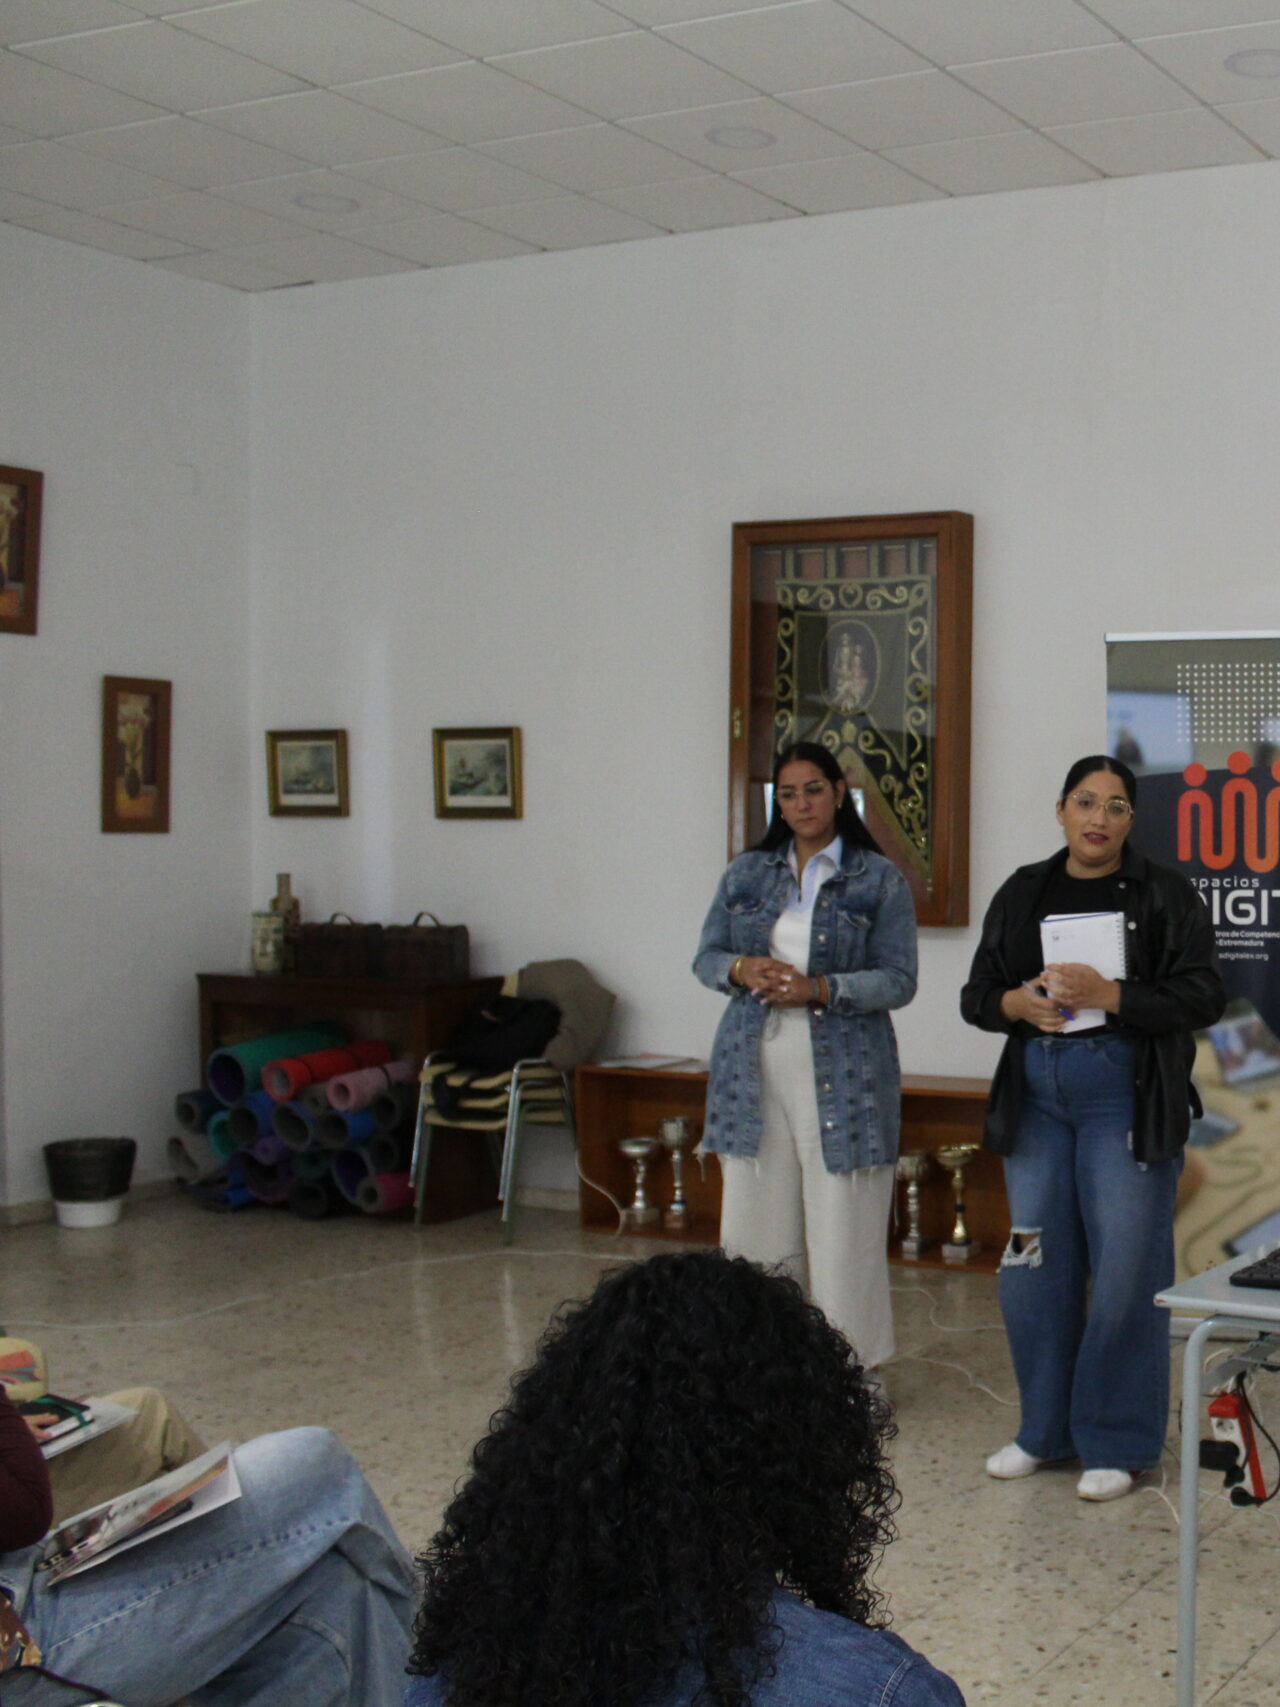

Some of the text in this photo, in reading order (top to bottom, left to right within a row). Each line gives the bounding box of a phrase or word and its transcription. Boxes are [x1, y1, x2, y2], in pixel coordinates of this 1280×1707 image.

[1190, 876, 1260, 889] spacios
[1215, 930, 1229, 938] tros
[1219, 939, 1264, 948] Extremadura
[1218, 951, 1269, 961] sdigitalex.org
